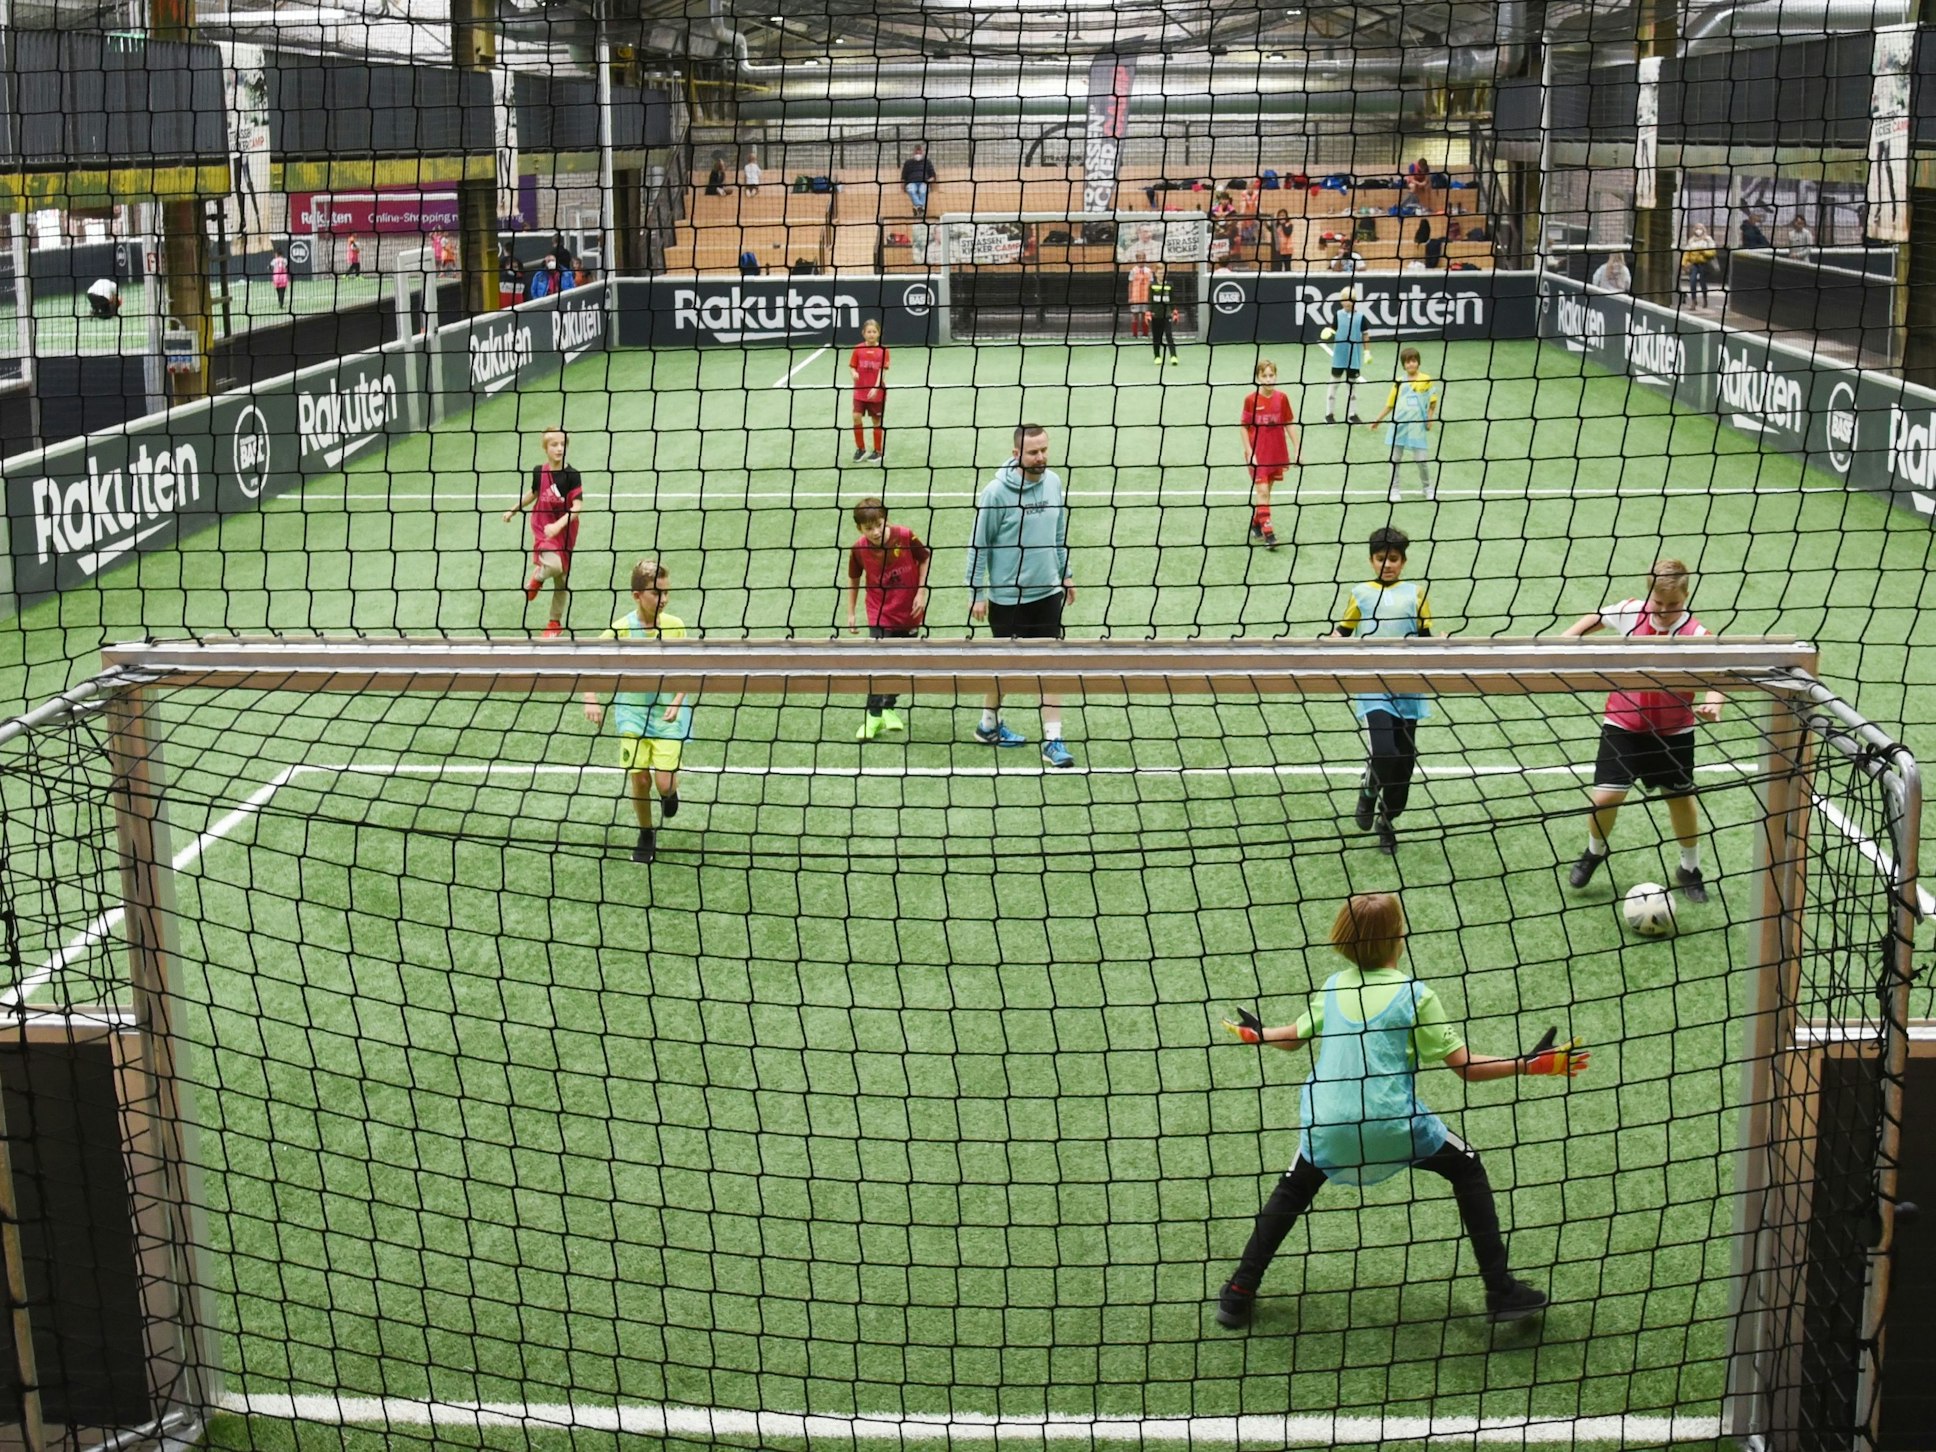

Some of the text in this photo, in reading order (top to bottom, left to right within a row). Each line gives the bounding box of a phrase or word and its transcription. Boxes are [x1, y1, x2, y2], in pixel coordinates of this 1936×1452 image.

[552, 300, 601, 351] Rakuten
[674, 286, 860, 330] Rakuten
[469, 322, 532, 386] Rakuten
[1625, 312, 1685, 383] Rakuten
[298, 372, 397, 456] Rakuten
[1716, 344, 1801, 433] Rakuten
[33, 443, 200, 565] Rakuten
